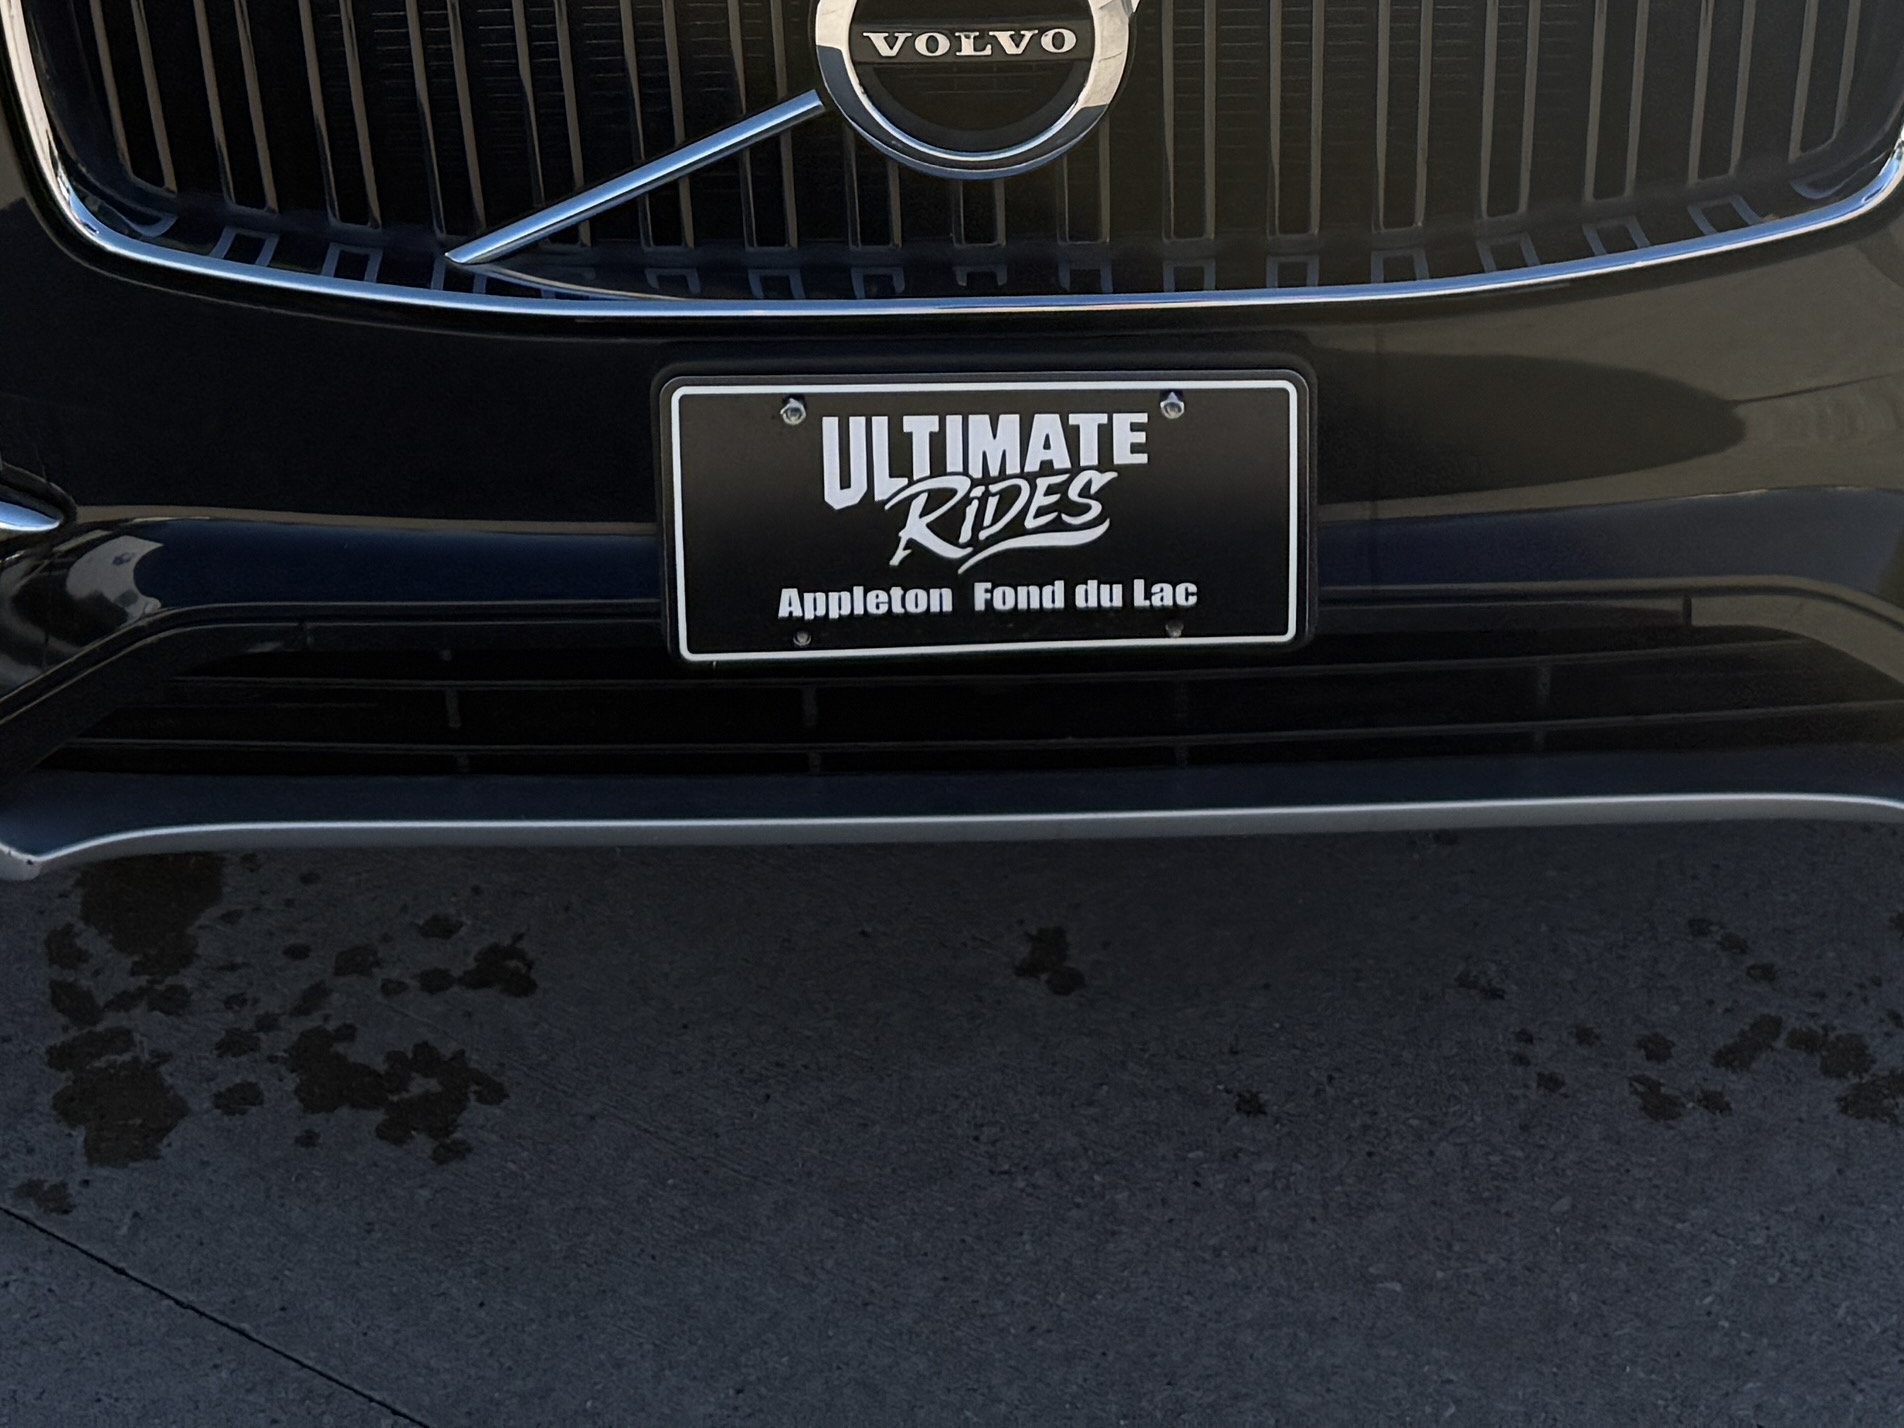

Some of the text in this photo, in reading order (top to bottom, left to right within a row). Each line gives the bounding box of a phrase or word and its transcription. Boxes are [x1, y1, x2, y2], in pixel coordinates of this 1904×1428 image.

[863, 28, 1077, 57] VOLVO
[820, 412, 1149, 512] ULTIMATE
[777, 576, 1198, 622] Appleton Fond du Lac
